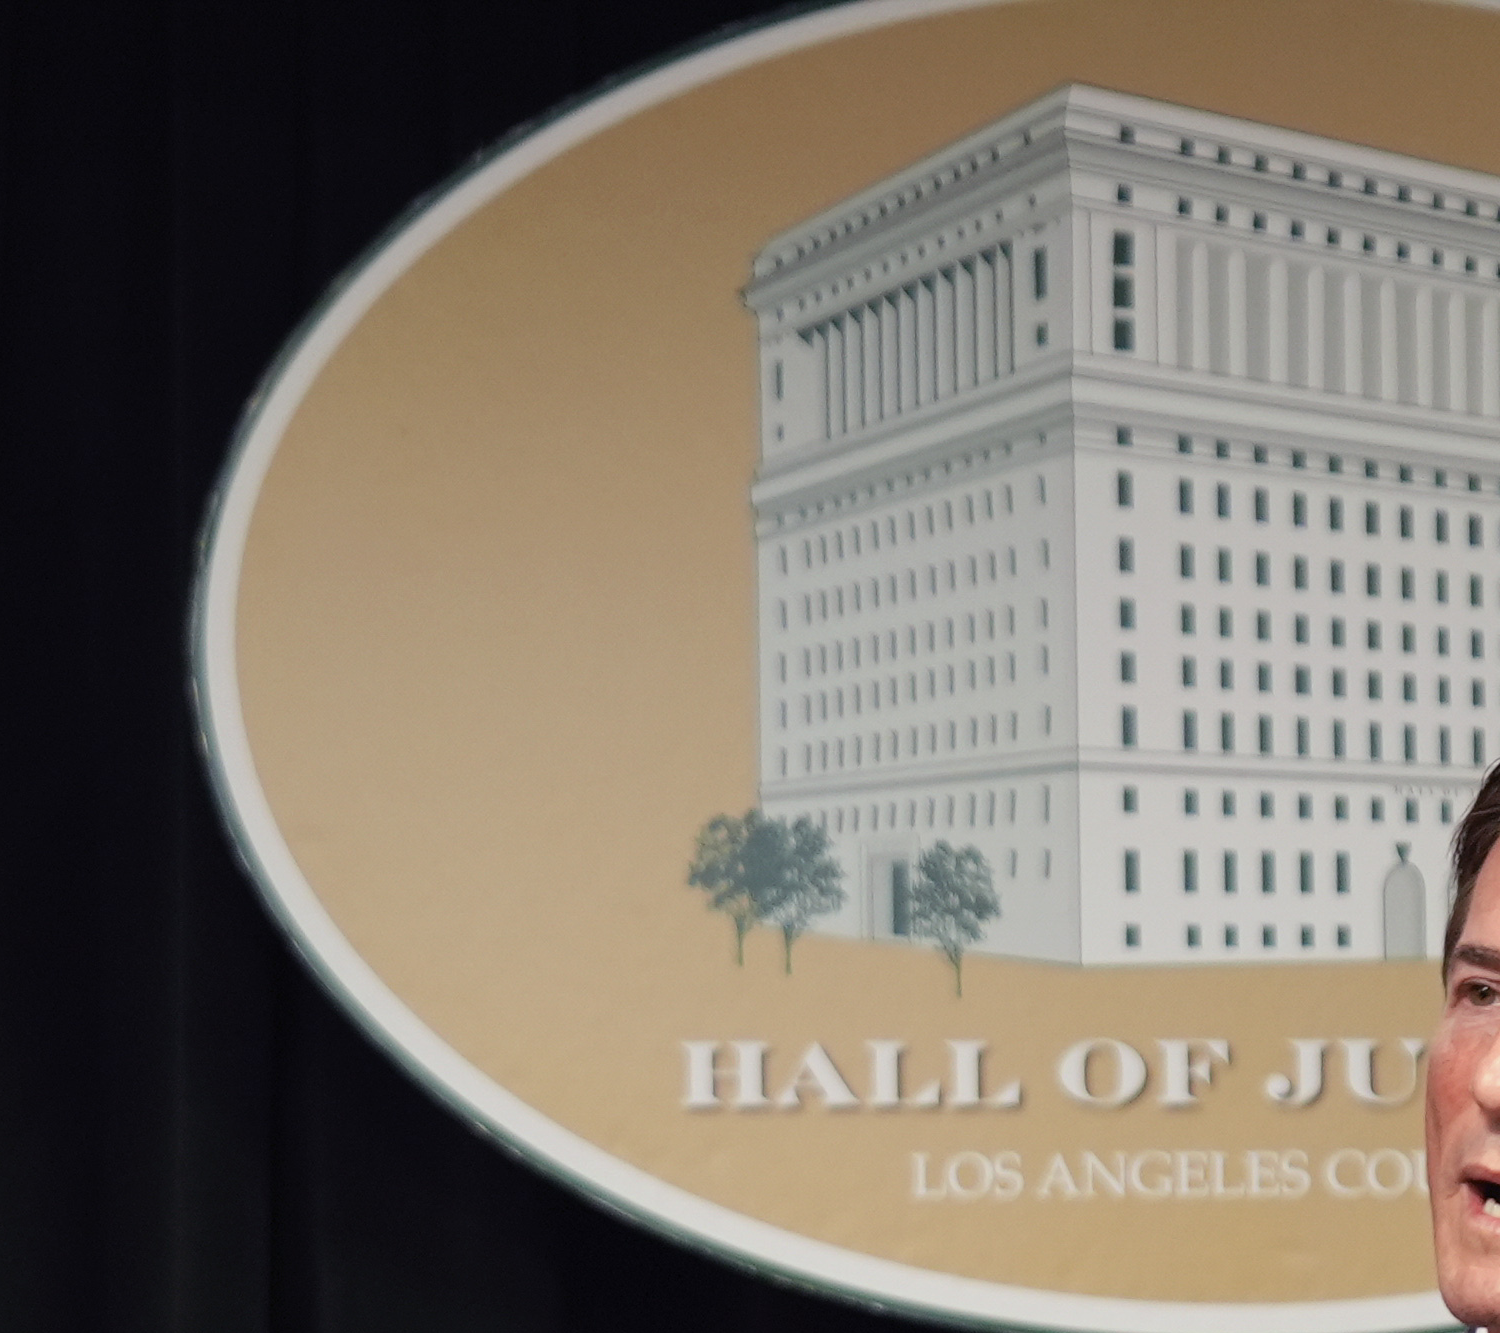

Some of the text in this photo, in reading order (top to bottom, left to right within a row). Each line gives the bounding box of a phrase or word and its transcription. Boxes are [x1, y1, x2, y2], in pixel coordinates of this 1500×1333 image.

[681, 1038, 1024, 1110] HALL
[1057, 1037, 1234, 1107] OF
[911, 1148, 1022, 1199] LOS
[1036, 1147, 1311, 1199] ANGELES
